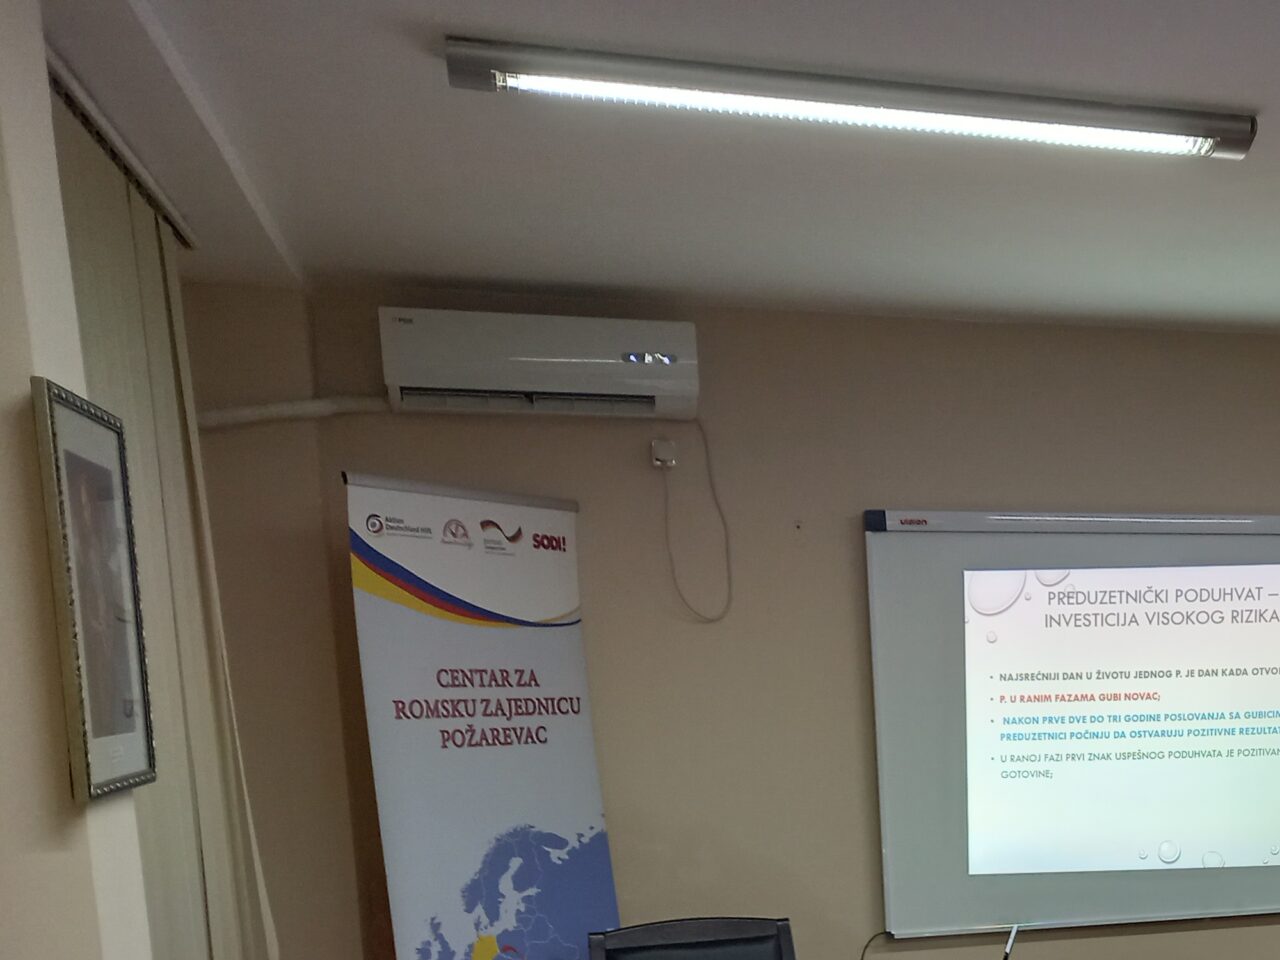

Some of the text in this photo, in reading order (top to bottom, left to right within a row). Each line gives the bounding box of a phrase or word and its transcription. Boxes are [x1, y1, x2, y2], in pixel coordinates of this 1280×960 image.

[532, 532, 567, 552] SODI!
[1047, 586, 1168, 606] PREDUZETNIČKI
[1175, 586, 1264, 603] PODUHVAT
[1044, 608, 1280, 628] INVESTICIJA VISOKOG RIZIKA
[436, 668, 540, 688] CENTAR ZA
[1062, 671, 1083, 681] DAN
[1085, 671, 1093, 681] U
[1095, 669, 1131, 681] ŽIVOTU
[1133, 669, 1173, 680] JEDNOG
[1175, 669, 1183, 679] P.
[1185, 669, 1195, 678] JE
[1198, 668, 1219, 678] DAN
[1221, 667, 1249, 677] KADA
[999, 691, 1161, 704] P. U RANIM FAZAMA GUBI NOVAC;
[393, 696, 581, 721] ROMSKU ZAJEDNICU
[1002, 715, 1040, 726] NAKON
[1042, 715, 1066, 725] PRVE
[1068, 714, 1087, 724] DVE
[1089, 714, 1104, 724] DO
[1107, 713, 1122, 723] TRI
[1124, 713, 1161, 723] GODINE
[1164, 712, 1226, 722] POSLOVANJA
[1229, 711, 1241, 721] SA
[439, 723, 548, 749] POŽAREVAC
[1000, 731, 1067, 742] PREDUZETNICI
[1069, 729, 1110, 741] POČINJU
[1113, 730, 1126, 740] DA
[1129, 729, 1184, 739] OSTVARUJU
[1187, 727, 1236, 737] POZITIVNE
[1000, 754, 1008, 764] U
[1010, 753, 1041, 763] RANOJ
[1044, 753, 1063, 762] FAZI
[1065, 752, 1085, 762] PRVI
[1087, 752, 1112, 761] ZNAK
[1115, 749, 1165, 761] USPEŠNOG
[1168, 748, 1223, 759] PODUHVATA
[1226, 748, 1235, 758] JE
[1000, 769, 1053, 779] GOTOVINE;
